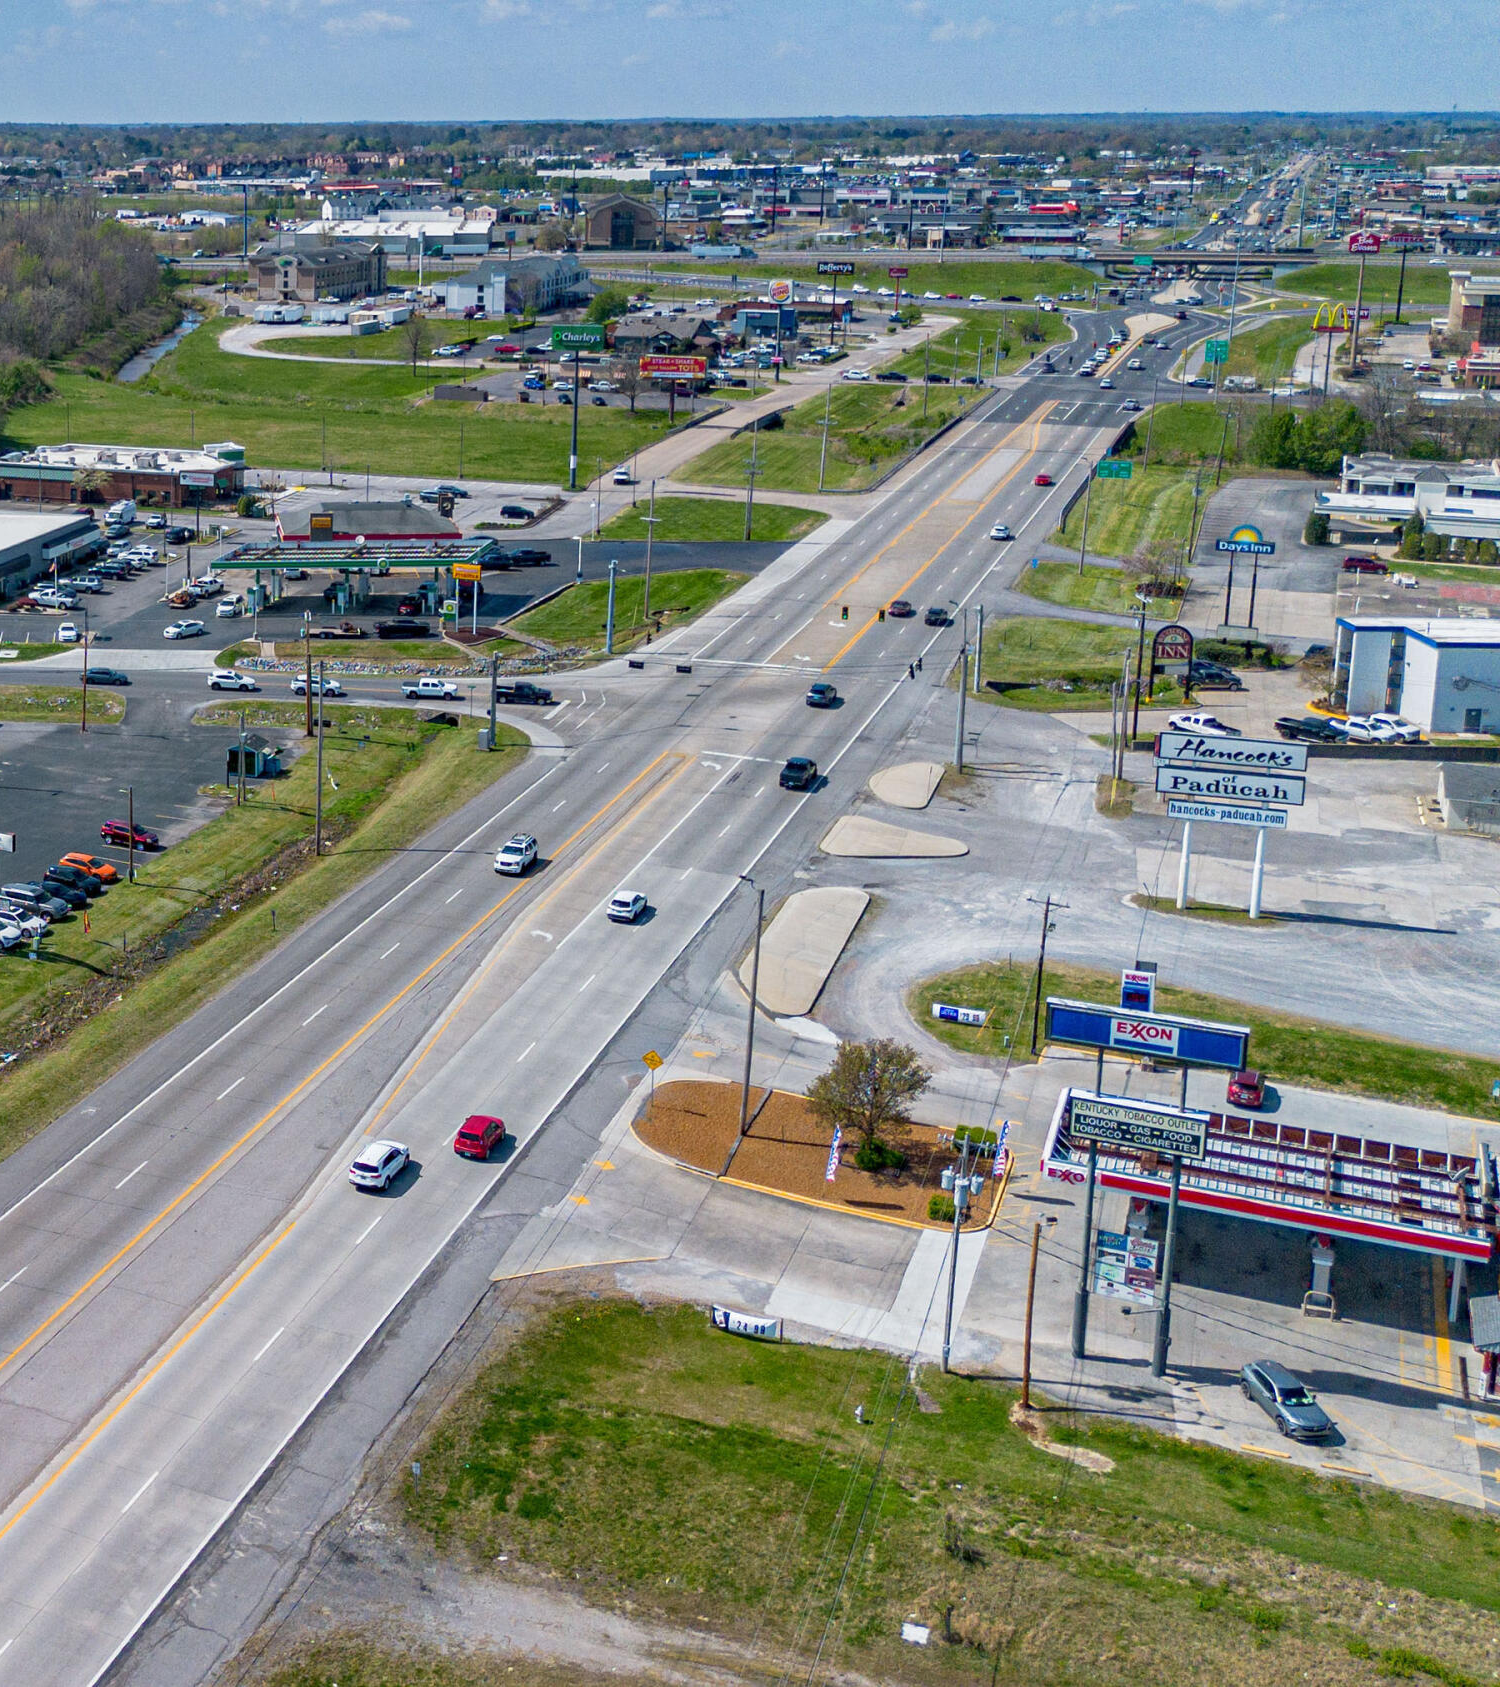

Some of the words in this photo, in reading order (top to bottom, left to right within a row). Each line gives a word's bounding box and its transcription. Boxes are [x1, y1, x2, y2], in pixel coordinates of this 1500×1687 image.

[772, 288, 790, 298] KING
[562, 332, 601, 344] Charleys
[1219, 541, 1249, 552] Days
[1250, 543, 1271, 553] Inn
[1157, 645, 1189, 658] INN
[1174, 738, 1293, 767] Hancock's
[1170, 775, 1289, 800] Paducah
[1222, 775, 1238, 783] of
[1170, 802, 1285, 825] hancocks-paducah.com
[1125, 973, 1149, 983] EXXON
[1116, 1021, 1173, 1042] EXXON
[1074, 1101, 1120, 1118] KENTUCKY
[1123, 1110, 1165, 1126] TOBACCO
[1167, 1118, 1202, 1132] OUTLET
[1075, 1123, 1122, 1140] TOBACCO
[1133, 1134, 1198, 1153] CIGARETTES
[1080, 1115, 1118, 1130] LIQUOR
[1129, 1124, 1151, 1136] GAS
[1162, 1131, 1193, 1143] FOOD
[1047, 1167, 1096, 1185] EXXO
